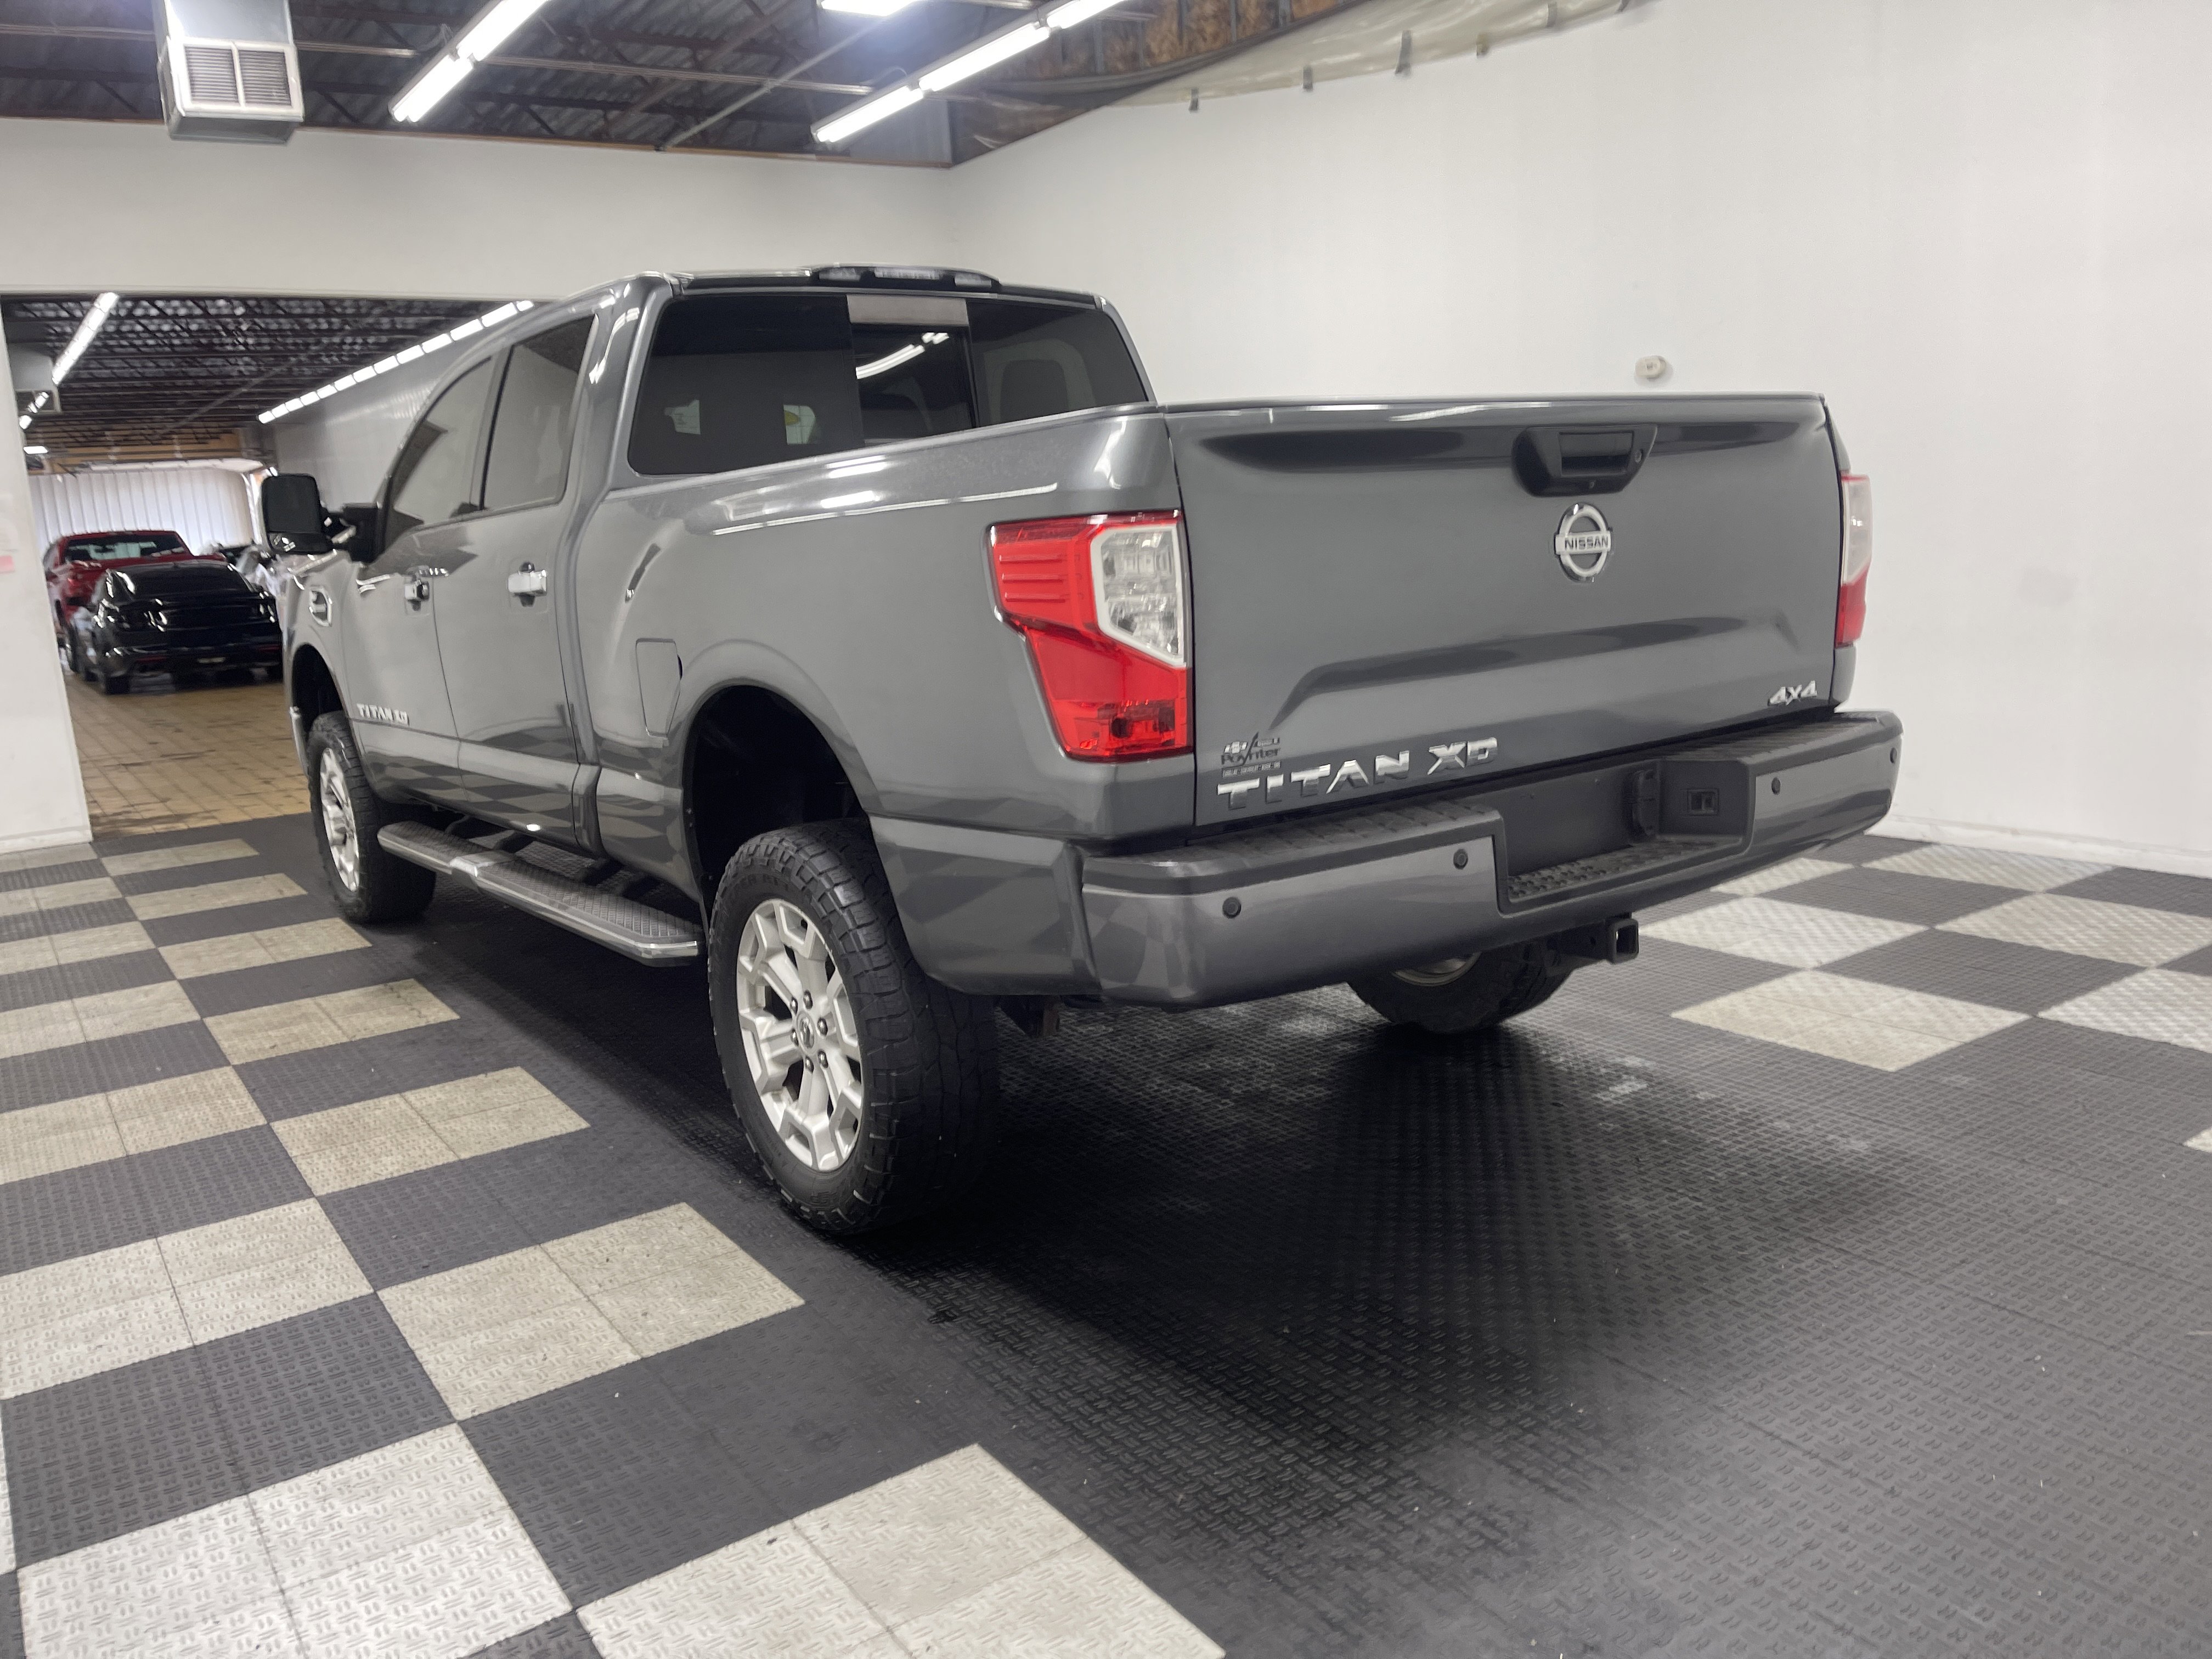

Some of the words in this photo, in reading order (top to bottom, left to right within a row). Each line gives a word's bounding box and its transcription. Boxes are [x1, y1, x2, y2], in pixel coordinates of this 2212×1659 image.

[1565, 535, 1609, 550] NISSAN
[356, 703, 394, 721] TITAN
[1217, 751, 1410, 810] TITAN
[1427, 737, 1498, 776] XD
